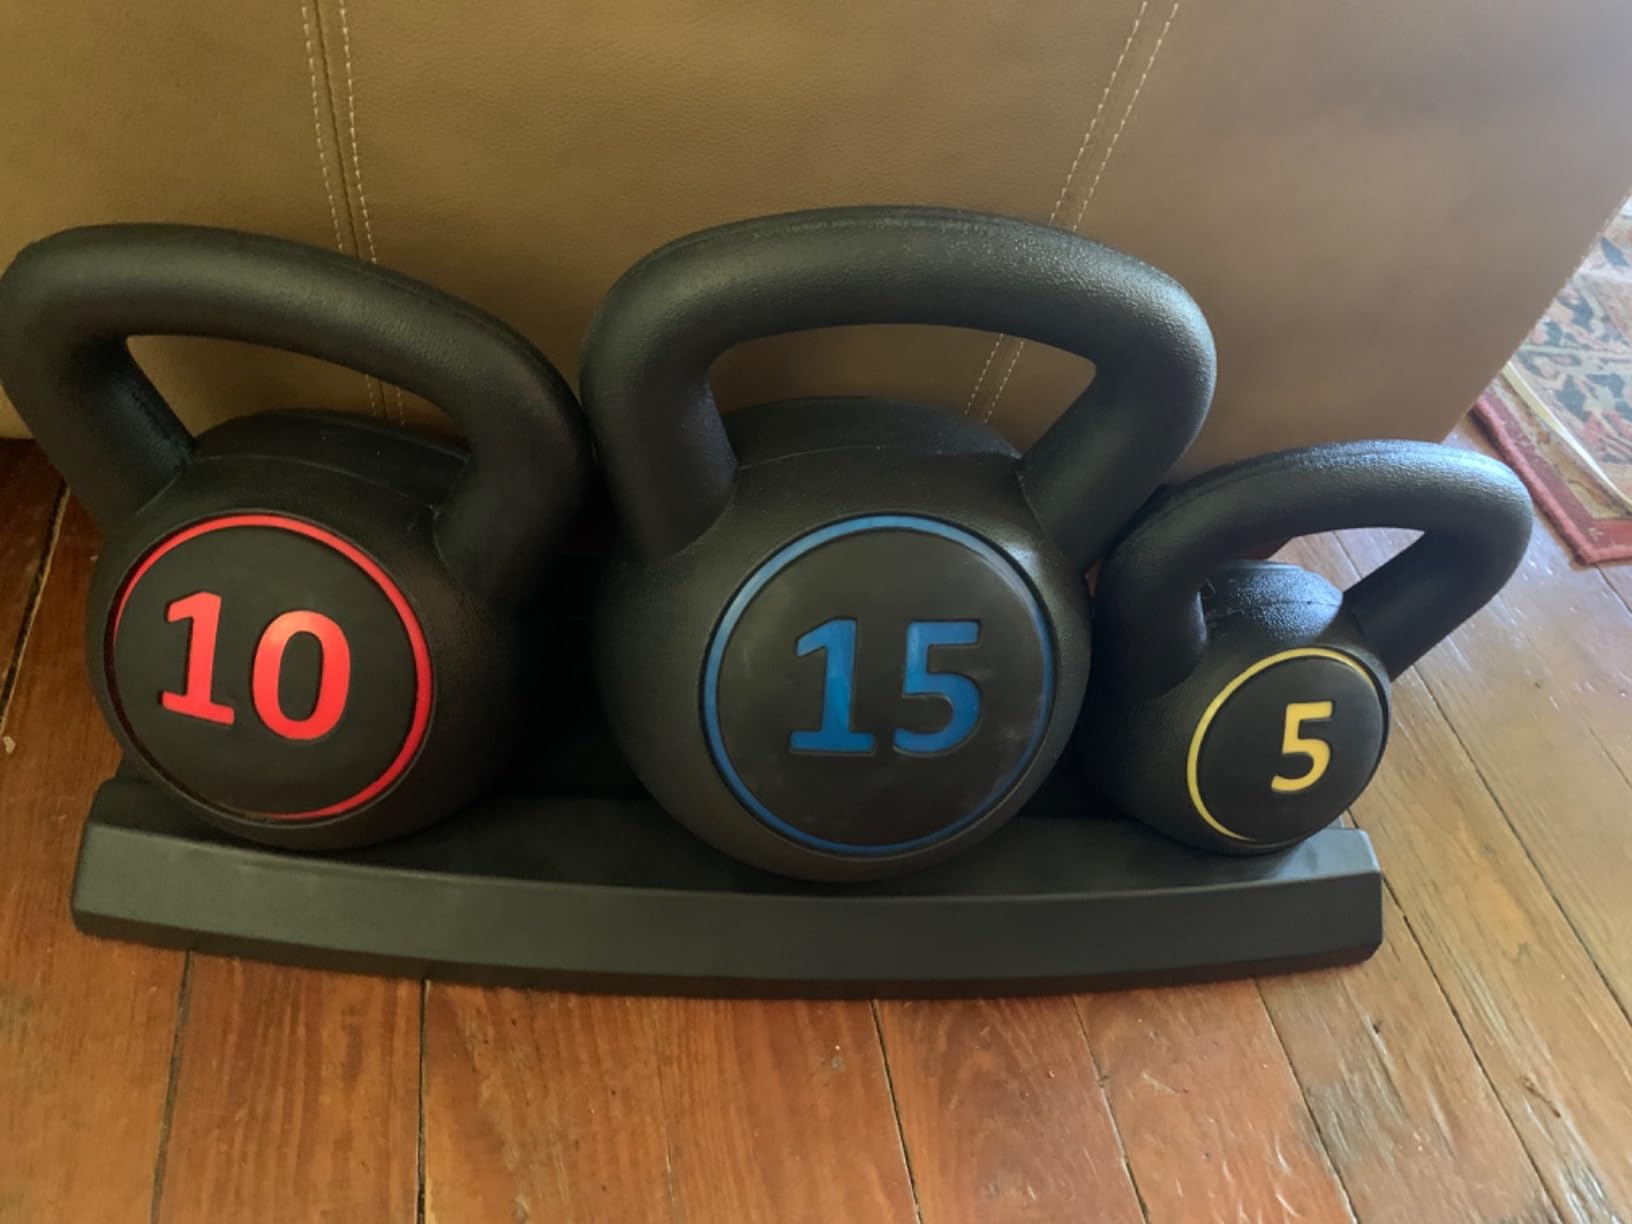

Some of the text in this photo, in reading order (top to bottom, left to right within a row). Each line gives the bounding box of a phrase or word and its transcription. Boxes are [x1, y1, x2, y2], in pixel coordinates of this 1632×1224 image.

[159, 590, 353, 742] 10
[789, 618, 983, 756] 15
[1270, 700, 1334, 794] 5
